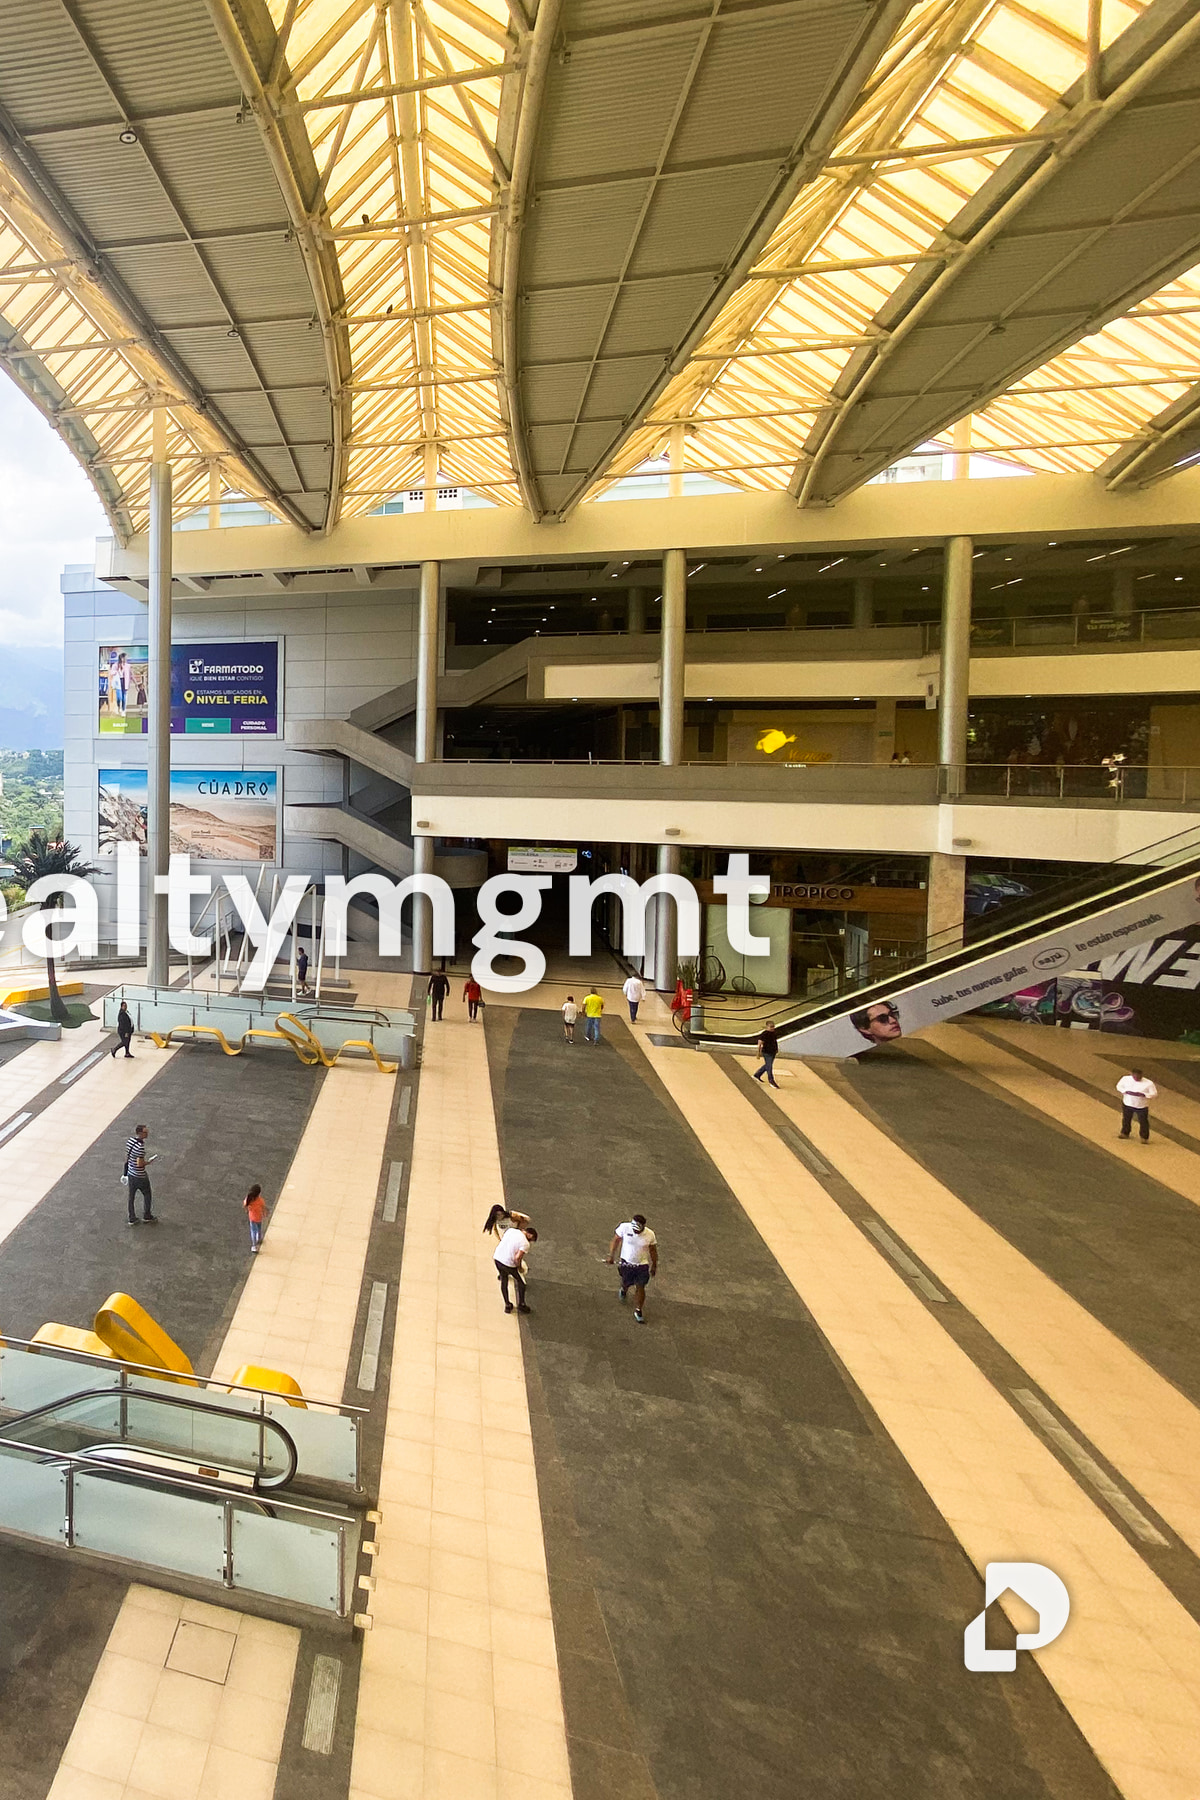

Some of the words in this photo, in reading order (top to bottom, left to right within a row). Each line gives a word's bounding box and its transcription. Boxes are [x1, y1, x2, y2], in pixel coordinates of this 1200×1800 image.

[203, 665, 264, 674] FARMATODO
[196, 695, 231, 705] NIVEL
[233, 695, 269, 705] FERIA
[773, 884, 855, 900] TROPICO
[931, 993, 958, 1008] Sube,
[956, 986, 973, 998] tus
[971, 975, 1004, 992] nuevas
[1003, 965, 1029, 983] gafas
[1075, 943, 1088, 952] te
[1087, 930, 1114, 949] están
[1112, 913, 1164, 938] esperando.
